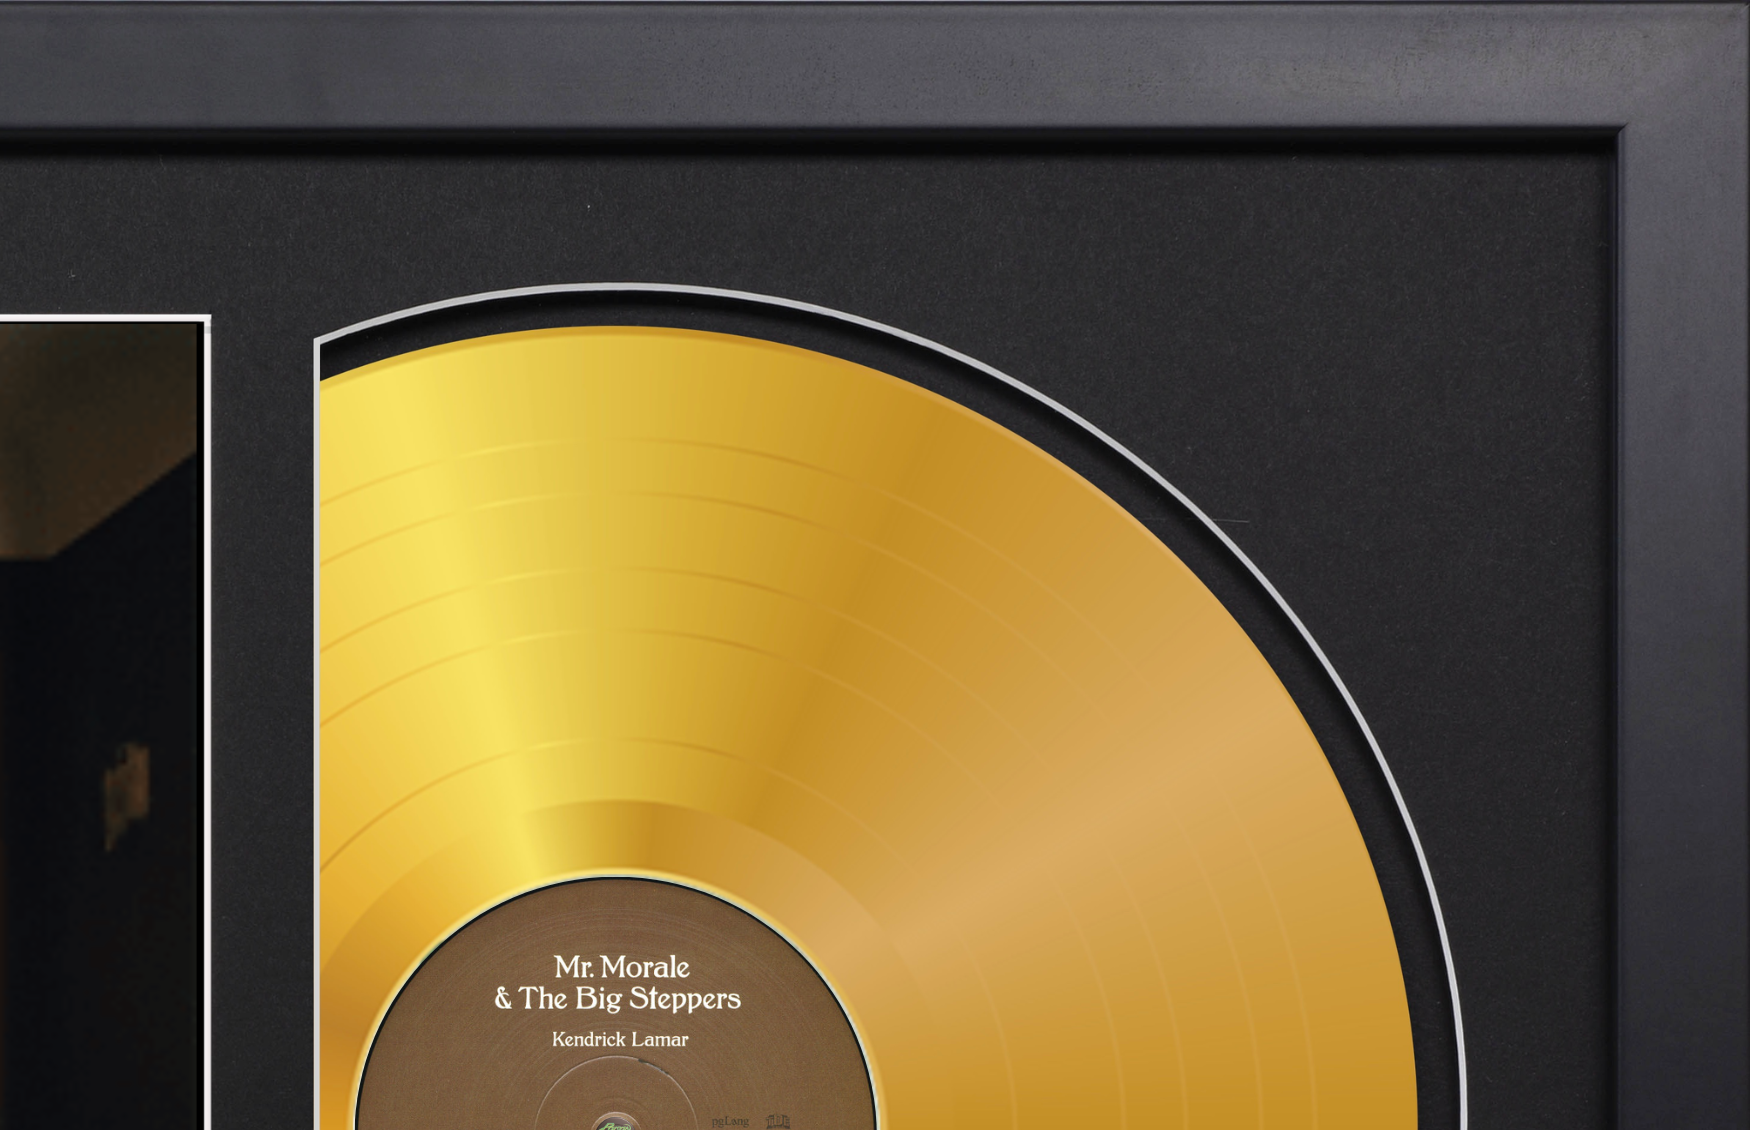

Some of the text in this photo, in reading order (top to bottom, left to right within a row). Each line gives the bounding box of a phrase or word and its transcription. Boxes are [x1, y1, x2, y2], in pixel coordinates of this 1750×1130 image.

[554, 955, 690, 978] Mr. Morale
[495, 986, 741, 1014] & The Big Steppers
[553, 1032, 689, 1046] Kendrick Lamar
